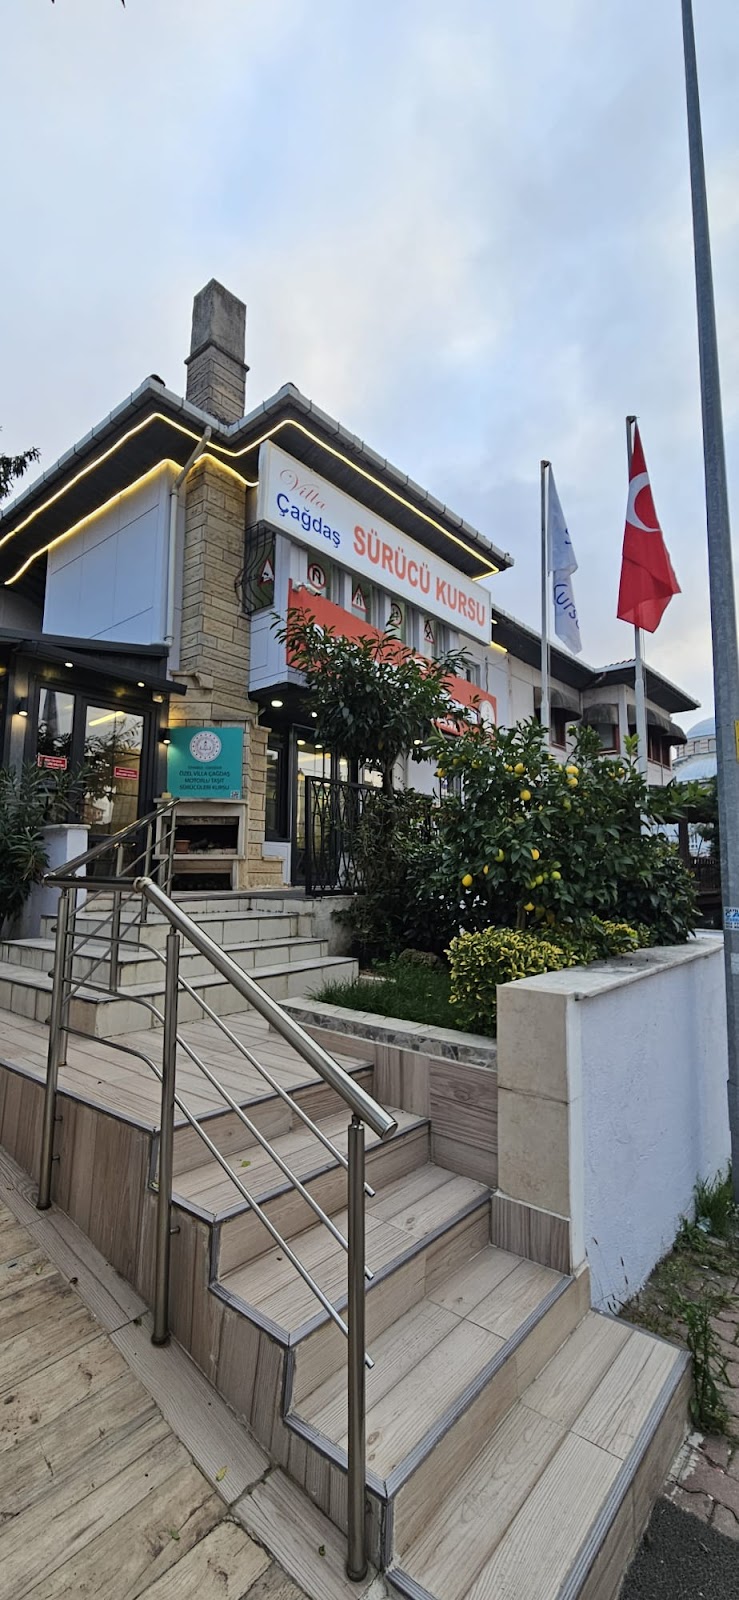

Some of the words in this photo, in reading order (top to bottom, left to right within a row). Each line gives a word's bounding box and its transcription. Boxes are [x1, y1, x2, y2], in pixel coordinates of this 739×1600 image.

[280, 469, 327, 511] Villa
[276, 492, 341, 548] Çağdaş
[353, 524, 431, 594] SÜRÜCÜ
[435, 577, 486, 628] KURSU
